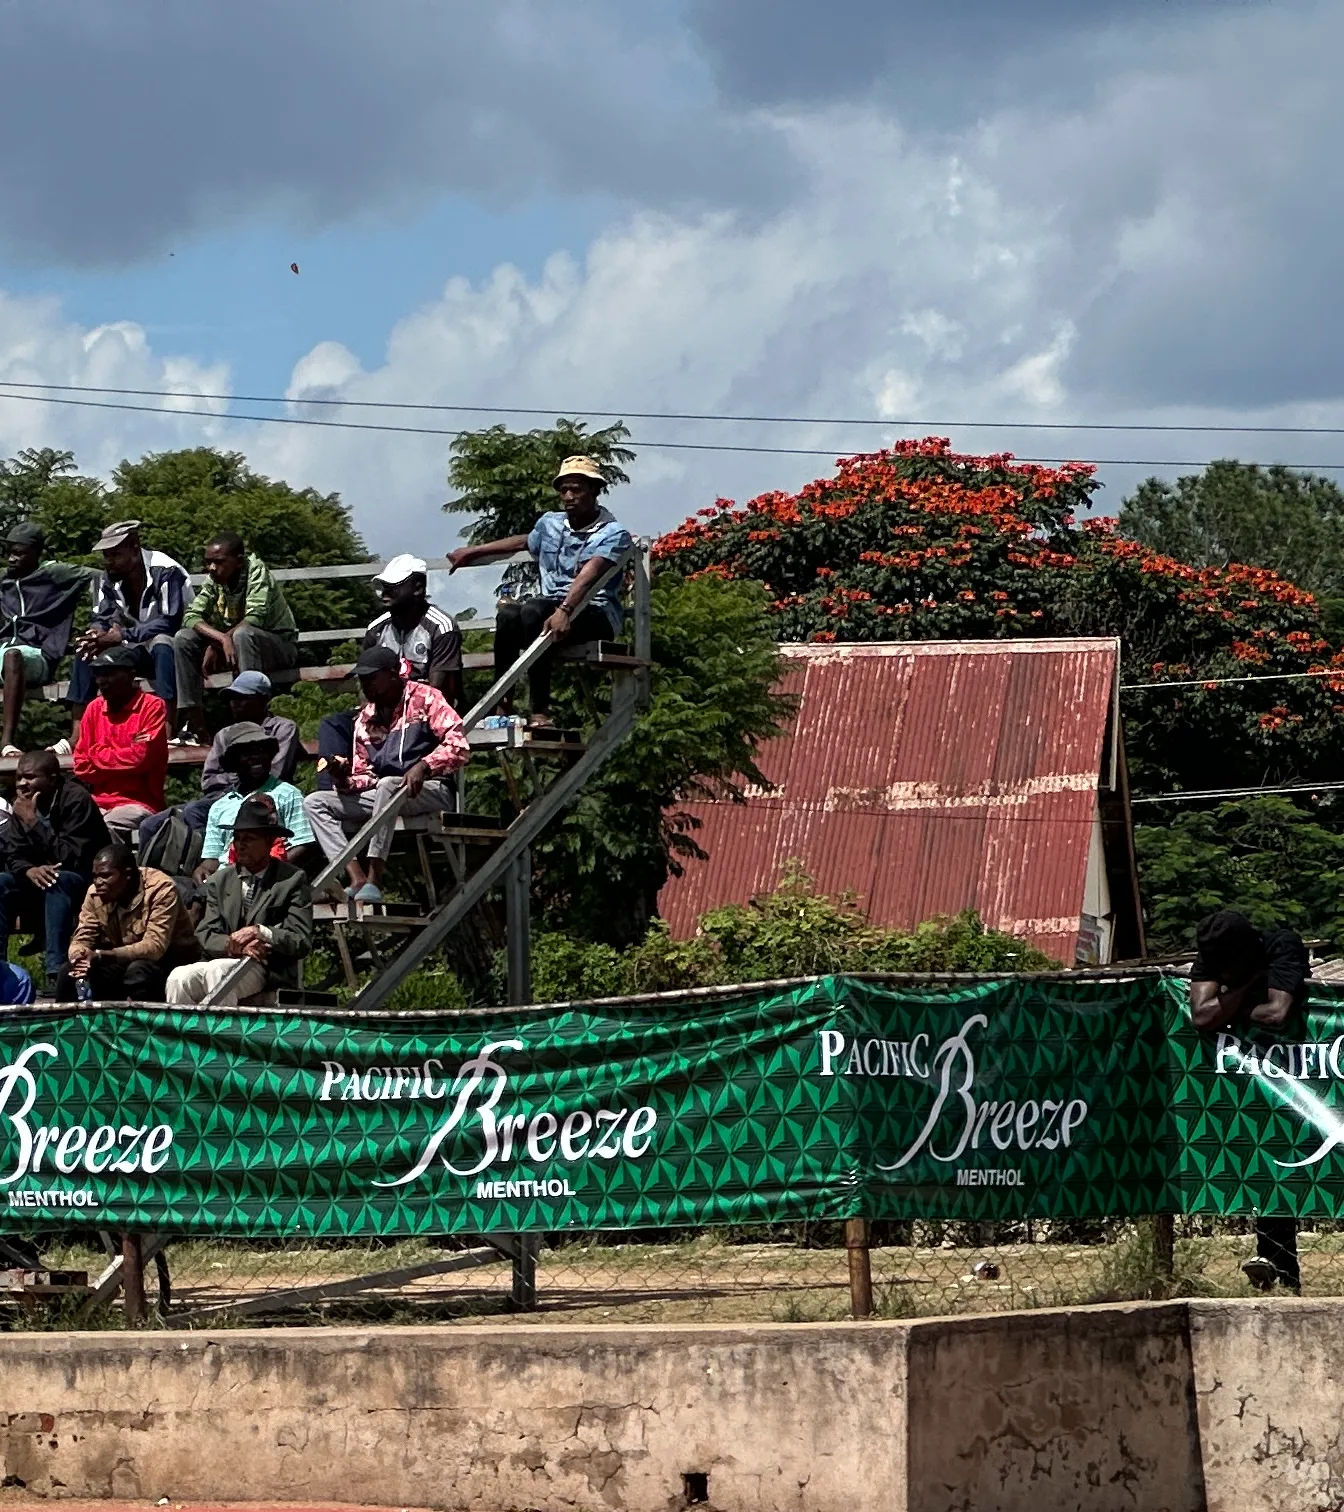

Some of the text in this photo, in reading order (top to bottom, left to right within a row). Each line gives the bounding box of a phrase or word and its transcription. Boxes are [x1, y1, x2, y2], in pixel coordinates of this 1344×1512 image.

[818, 1030, 930, 1079] PACIFIC
[320, 1058, 446, 1102] PACIFIC
[876, 1013, 1088, 1171] Breeze
[371, 1038, 658, 1188] Breeze
[7, 1188, 99, 1207] MENTHOL
[476, 1179, 577, 1199] MENTHOL
[956, 1168, 1025, 1186] MENTHOL
